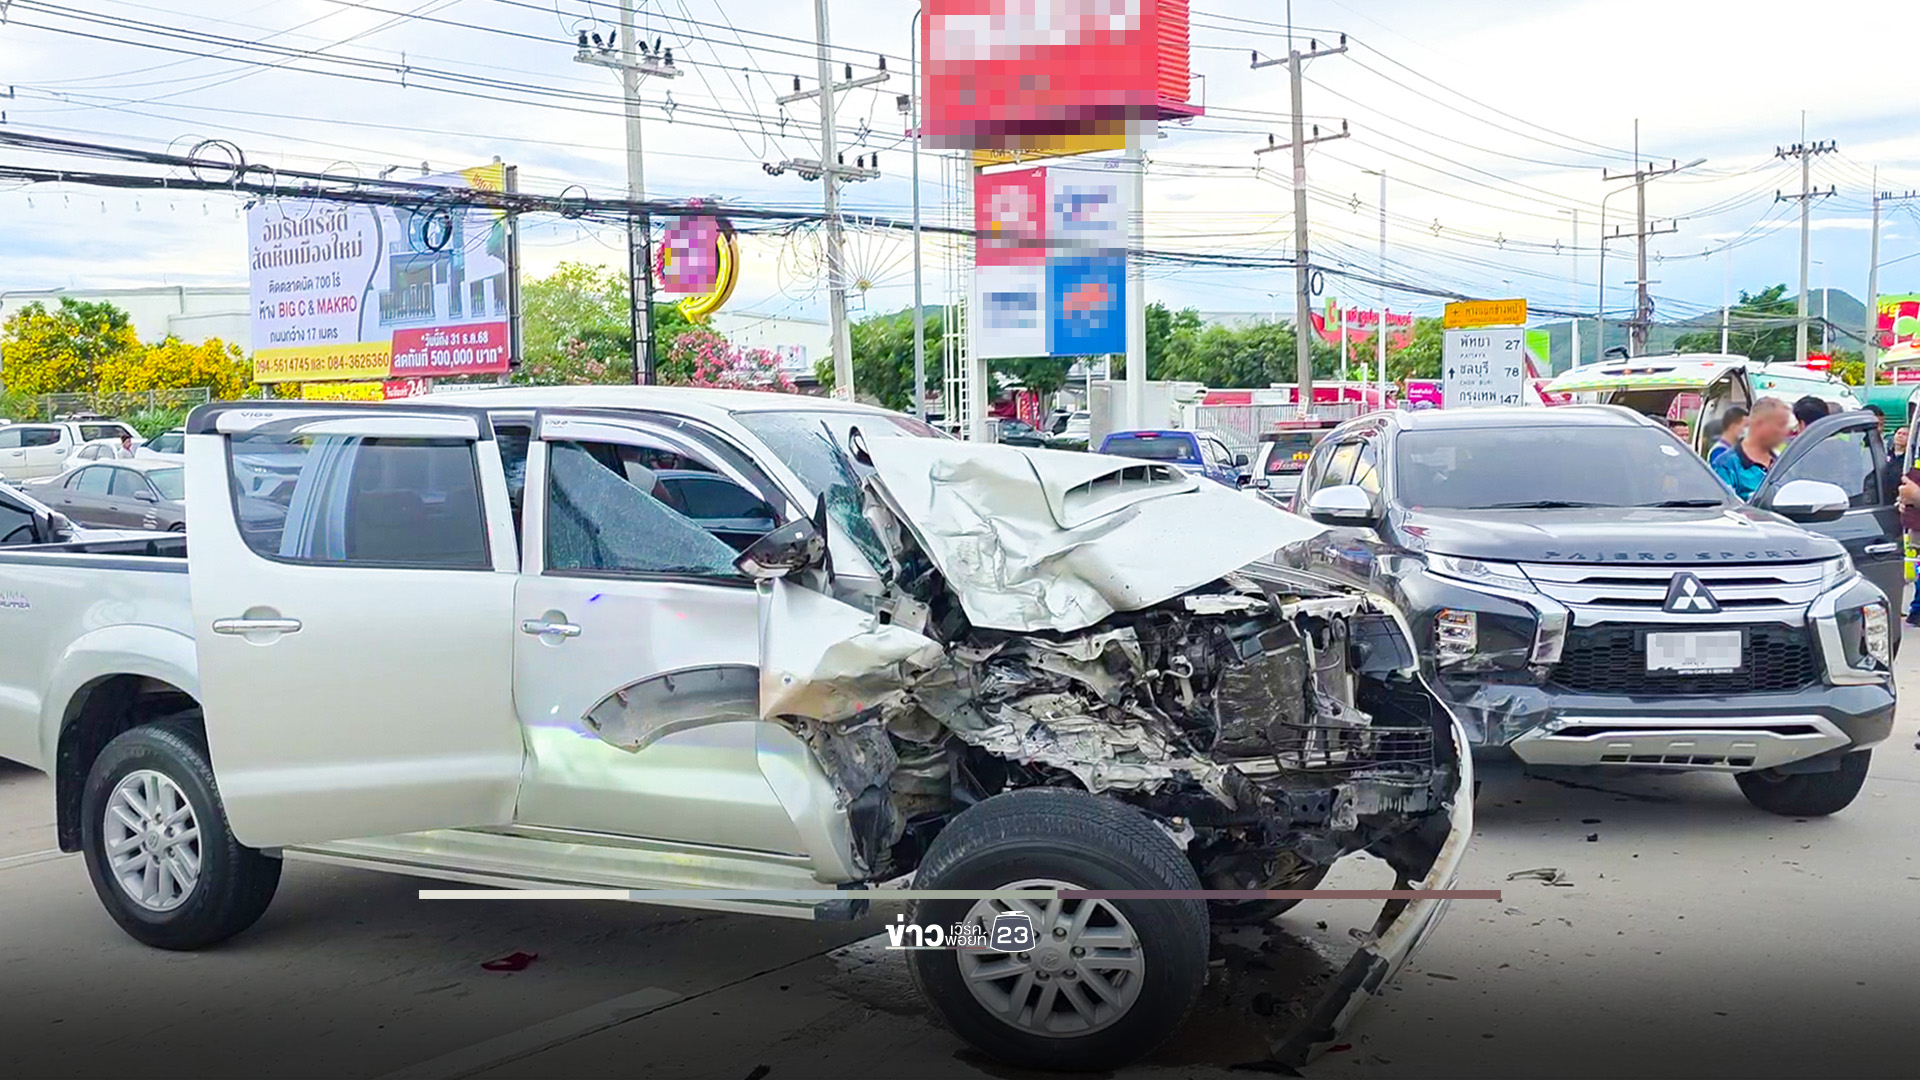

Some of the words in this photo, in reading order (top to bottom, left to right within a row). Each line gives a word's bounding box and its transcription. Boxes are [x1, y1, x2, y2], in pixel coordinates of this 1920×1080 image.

[315, 275, 331, 289] 700
[259, 300, 275, 319] ห้าง
[278, 301, 296, 318] BIG
[298, 300, 306, 317] C
[308, 299, 315, 316] &
[317, 295, 357, 314] MAKRO
[307, 328, 316, 340] 17
[319, 327, 338, 339] เมตร
[450, 333, 460, 345] 31
[1460, 334, 1490, 347] พัทยา
[1505, 340, 1520, 350] 27
[430, 348, 474, 368] 500,000
[1460, 361, 1489, 377] ชลบุรี
[1505, 367, 1519, 377] 78
[1460, 391, 1497, 404] กรุงเทพ
[1500, 394, 1519, 404] 147
[1544, 551, 1677, 562] PAJERO
[1695, 549, 1801, 560] SPORT
